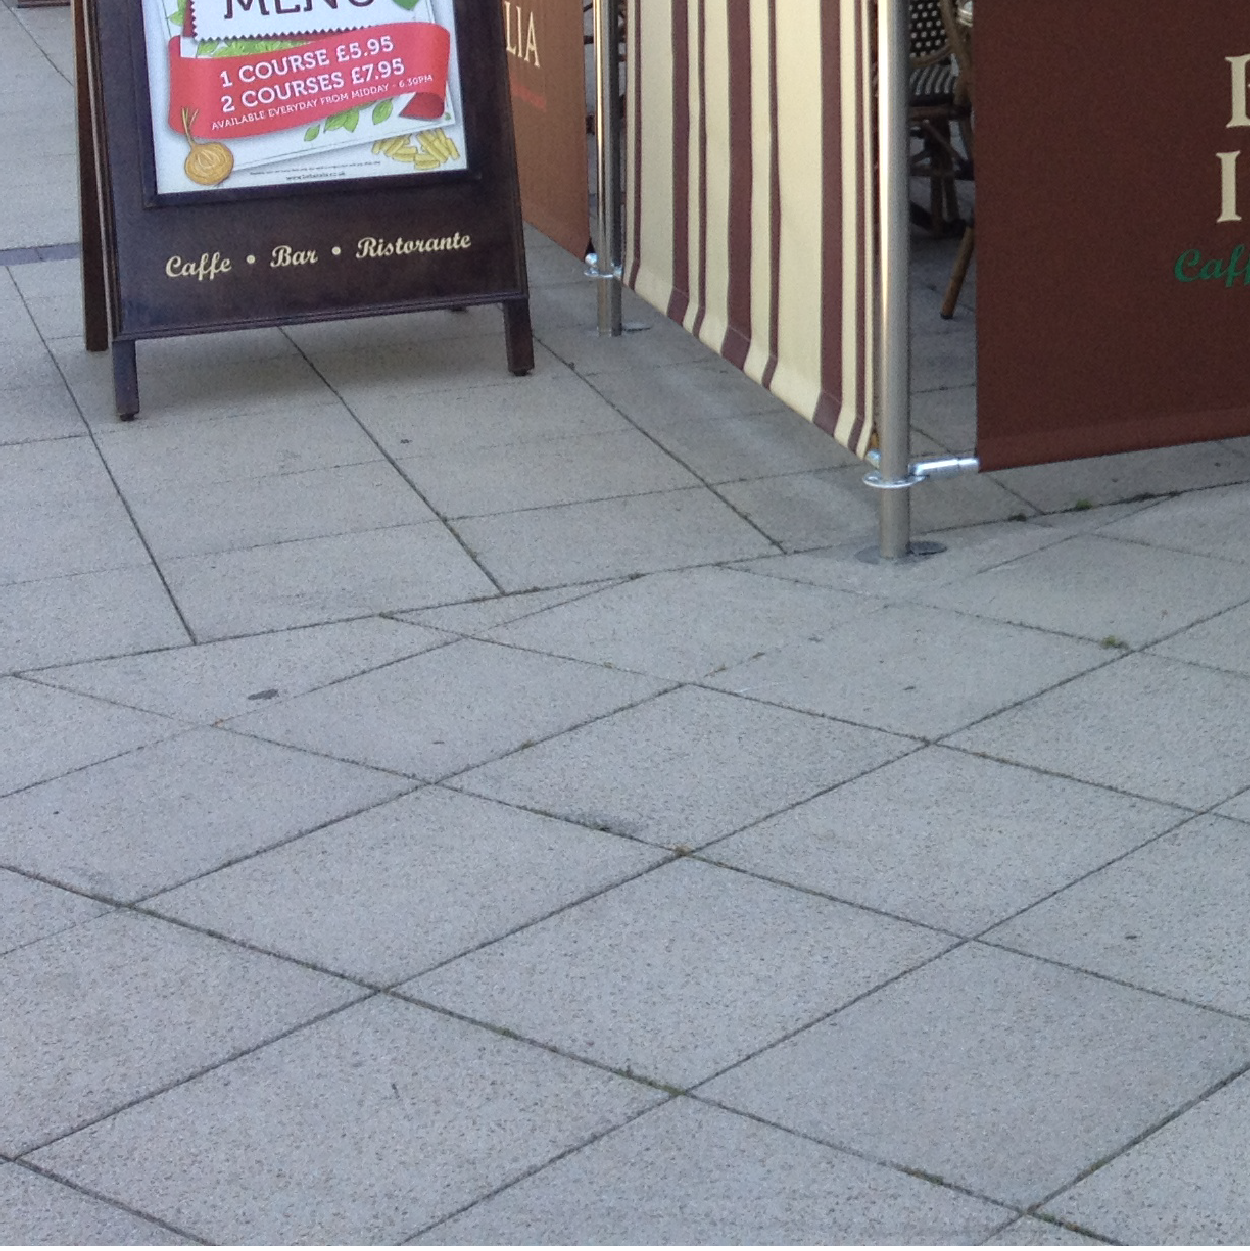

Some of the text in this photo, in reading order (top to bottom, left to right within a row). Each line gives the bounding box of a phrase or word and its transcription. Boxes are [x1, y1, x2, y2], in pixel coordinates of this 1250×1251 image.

[219, 35, 394, 87] 1 COURSE £5.95
[220, 57, 405, 113] 2 COURSES £7.95
[211, 111, 265, 131] AVAILABLE
[268, 99, 318, 119] EVERYDAY
[320, 92, 349, 106] FROM
[351, 83, 390, 100] MIDDAY
[399, 73, 433, 89] 6.30PM
[165, 232, 472, 281] Caffe Bar Ristorante
